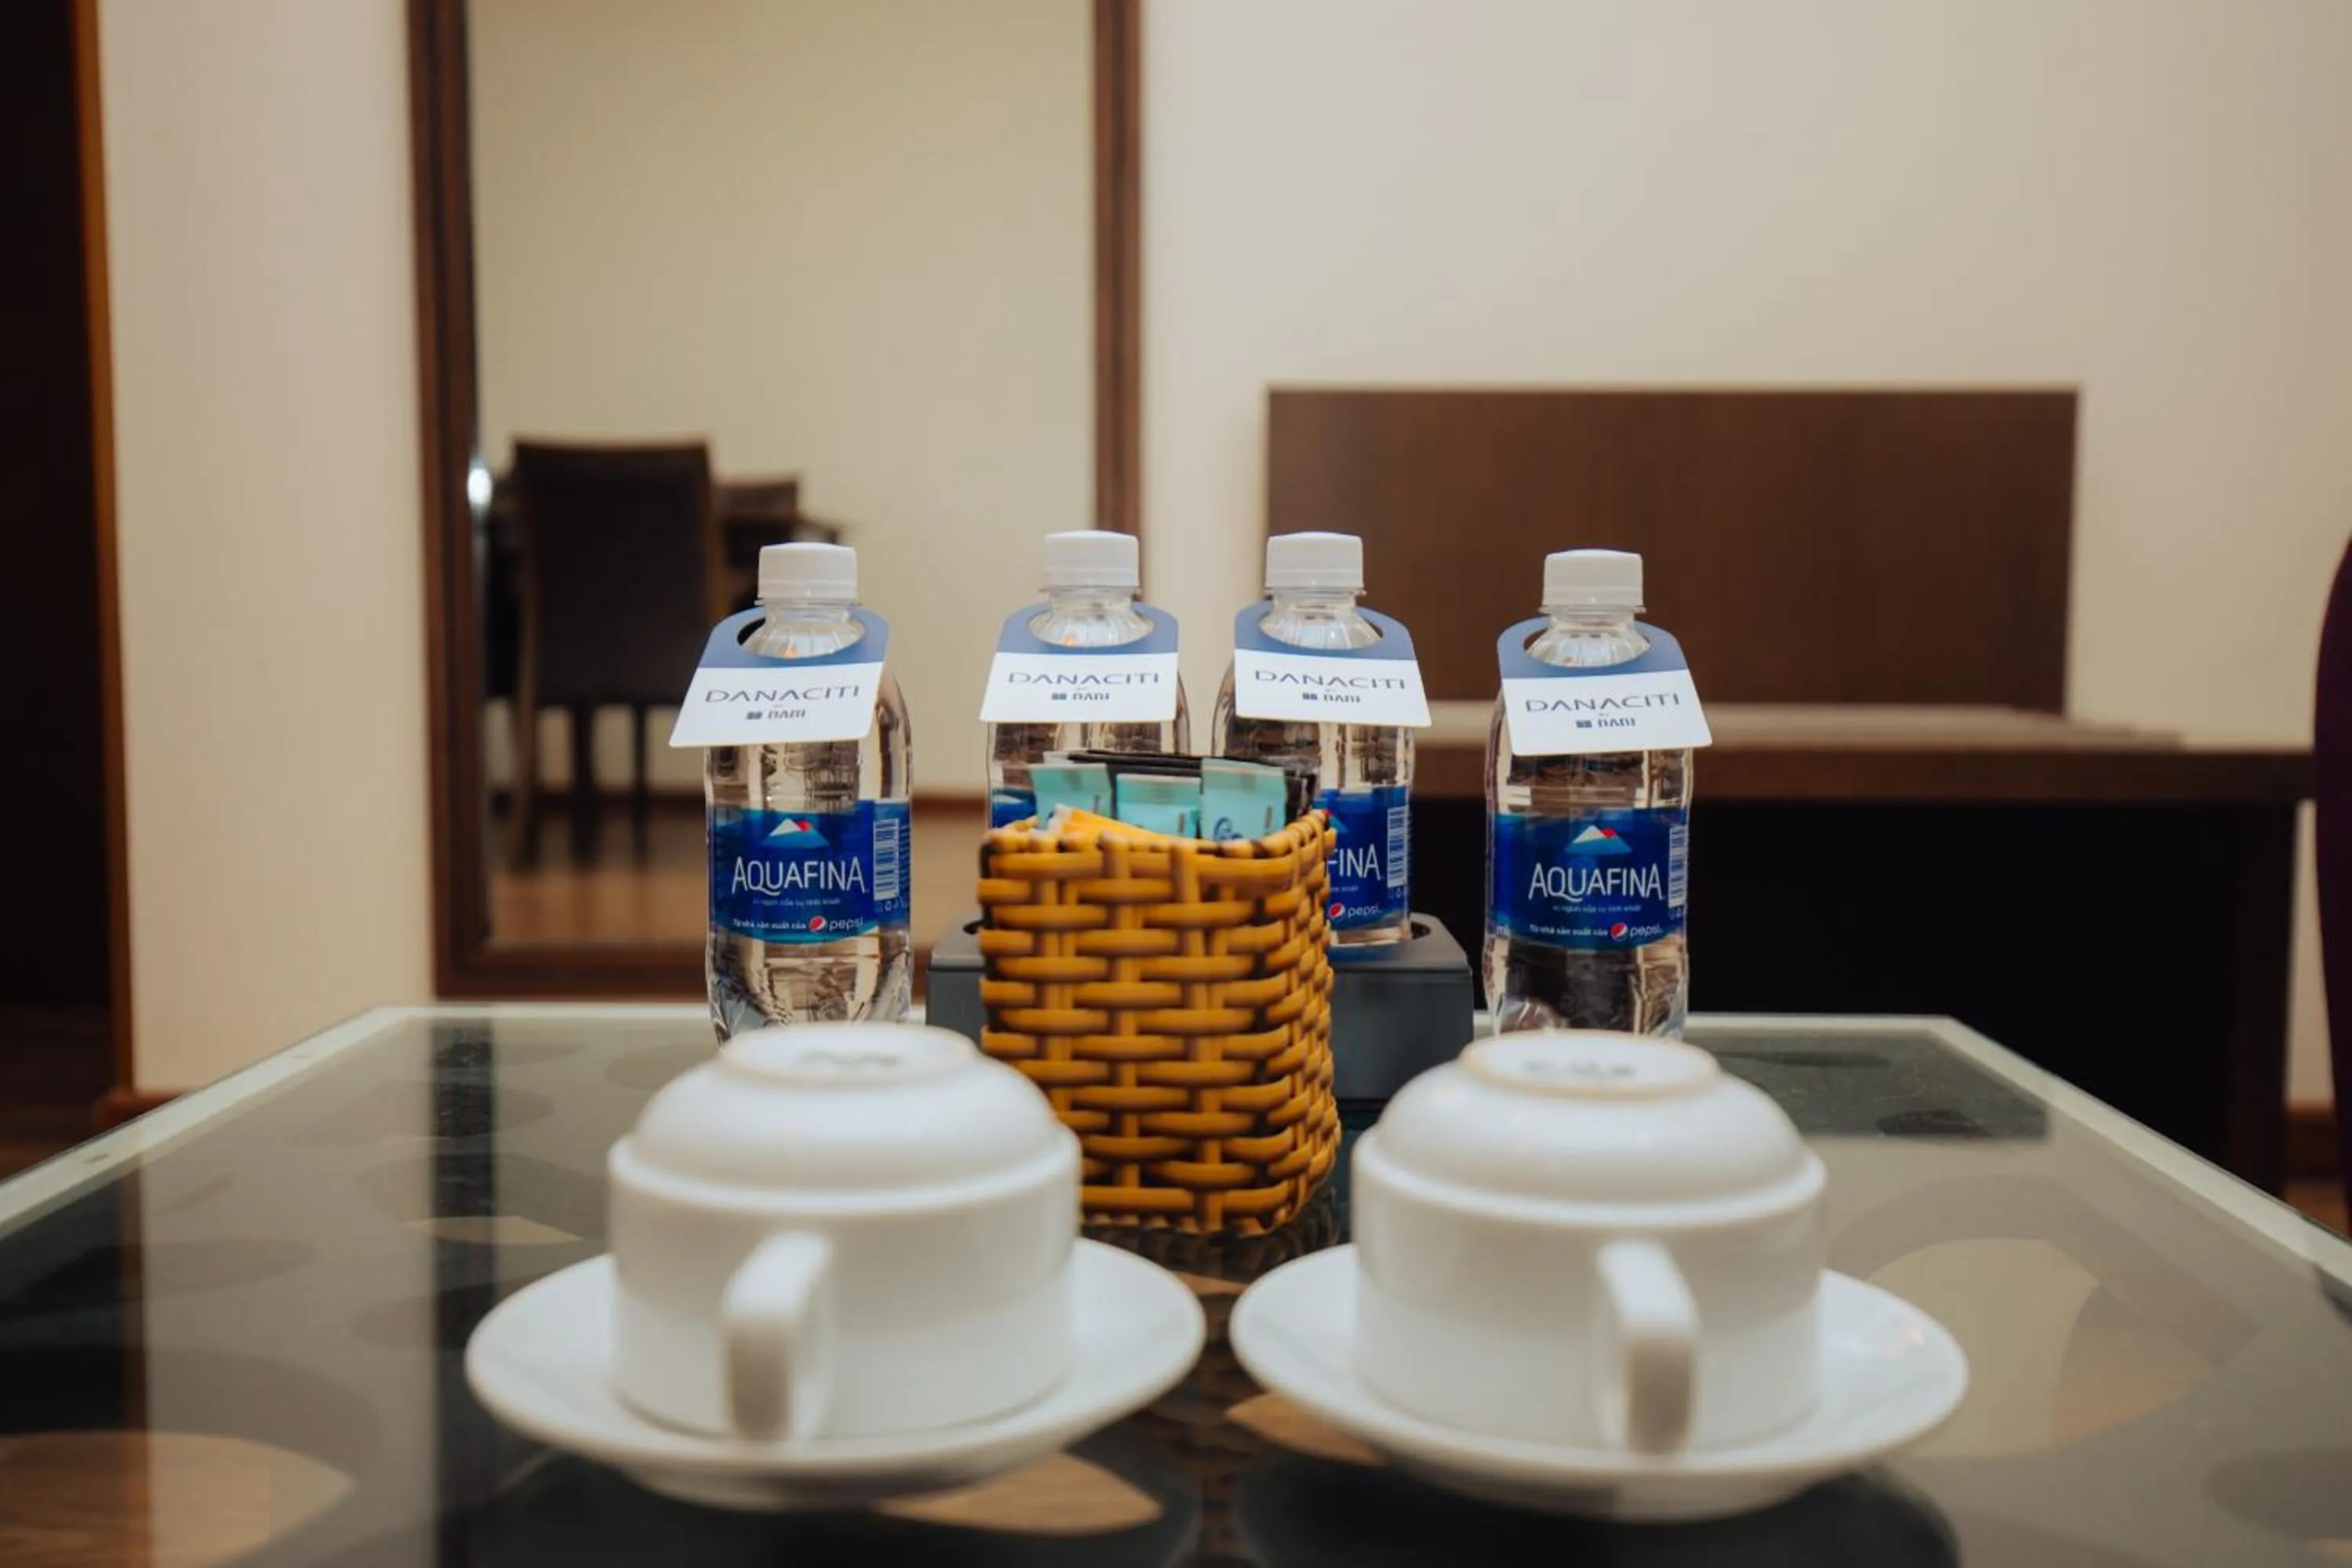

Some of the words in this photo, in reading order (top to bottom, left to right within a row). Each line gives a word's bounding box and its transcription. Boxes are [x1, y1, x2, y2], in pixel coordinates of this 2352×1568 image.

[1008, 672, 1159, 685] DANACITI
[1255, 670, 1405, 689] DANACITI
[704, 685, 859, 702] DANACITI
[1526, 692, 1679, 712] DANACITI
[731, 856, 866, 896] AQUAFINA
[1527, 862, 1664, 902] AQUAFINA
[1348, 903, 1380, 920] pepsi
[829, 916, 864, 931] pepsi
[1629, 924, 1662, 940] pepsi
